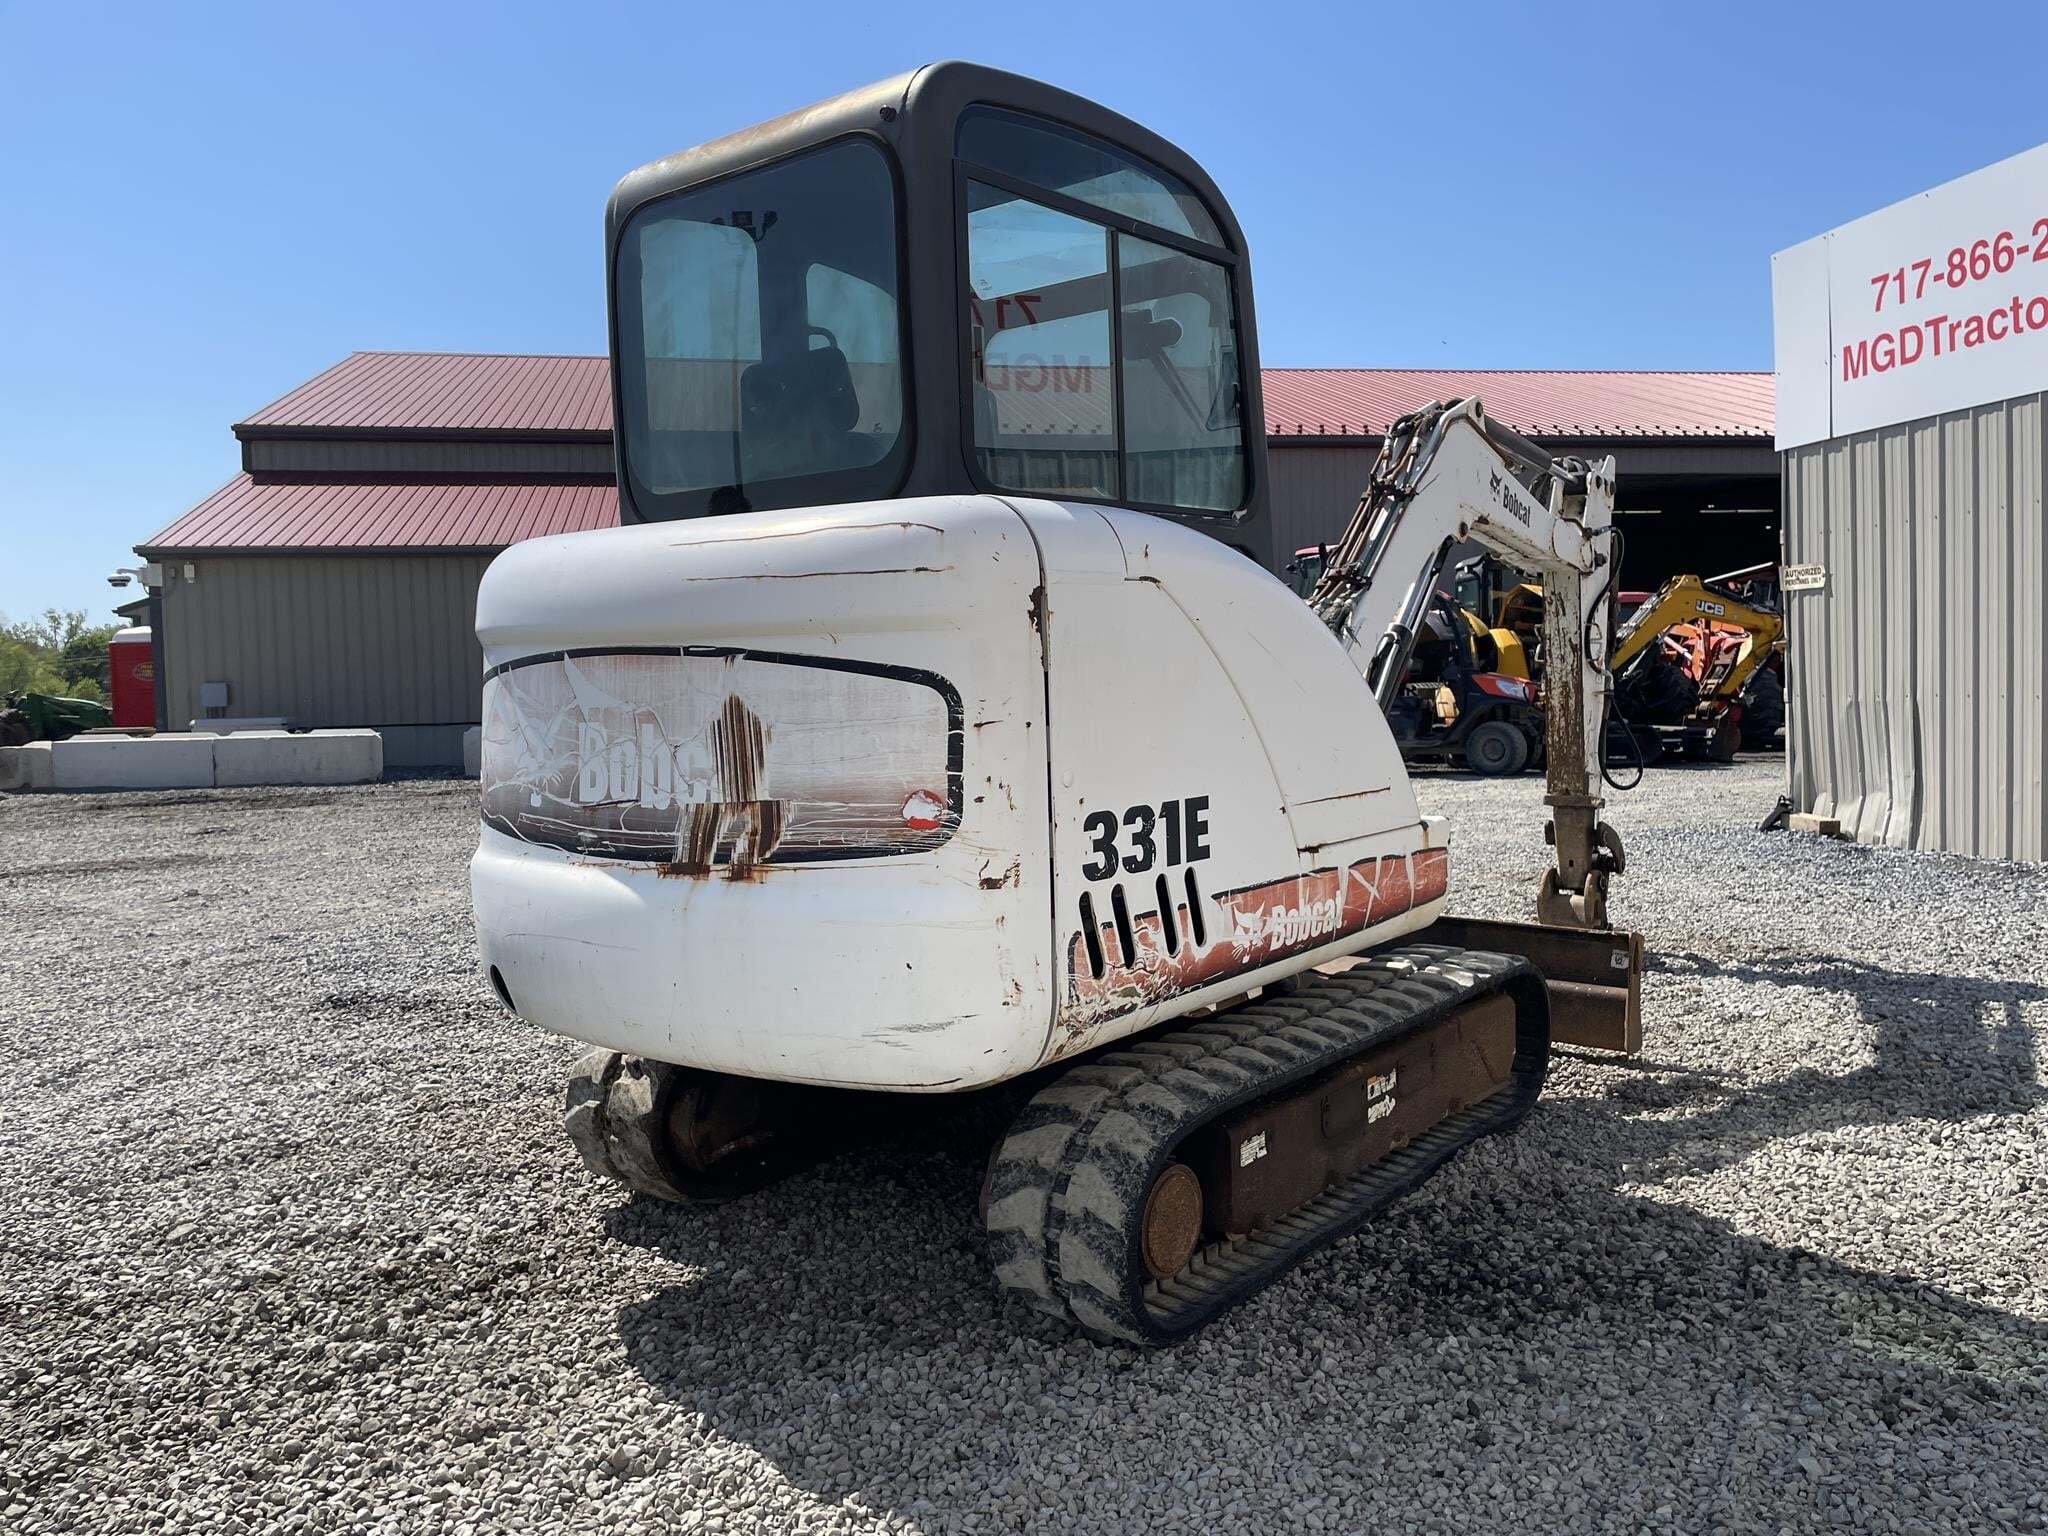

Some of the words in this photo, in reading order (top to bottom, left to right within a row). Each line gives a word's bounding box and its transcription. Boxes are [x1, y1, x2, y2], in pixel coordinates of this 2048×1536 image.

[1870, 217, 2048, 313] 717-866-2
[1842, 295, 2048, 382] MGDTracto
[1503, 484, 1531, 528] Bobcat
[1785, 566, 1822, 578] AUTHORIZED
[1696, 600, 1725, 616] JCB
[1082, 795, 1211, 882] 331E
[1269, 889, 1343, 952] Bobcat
